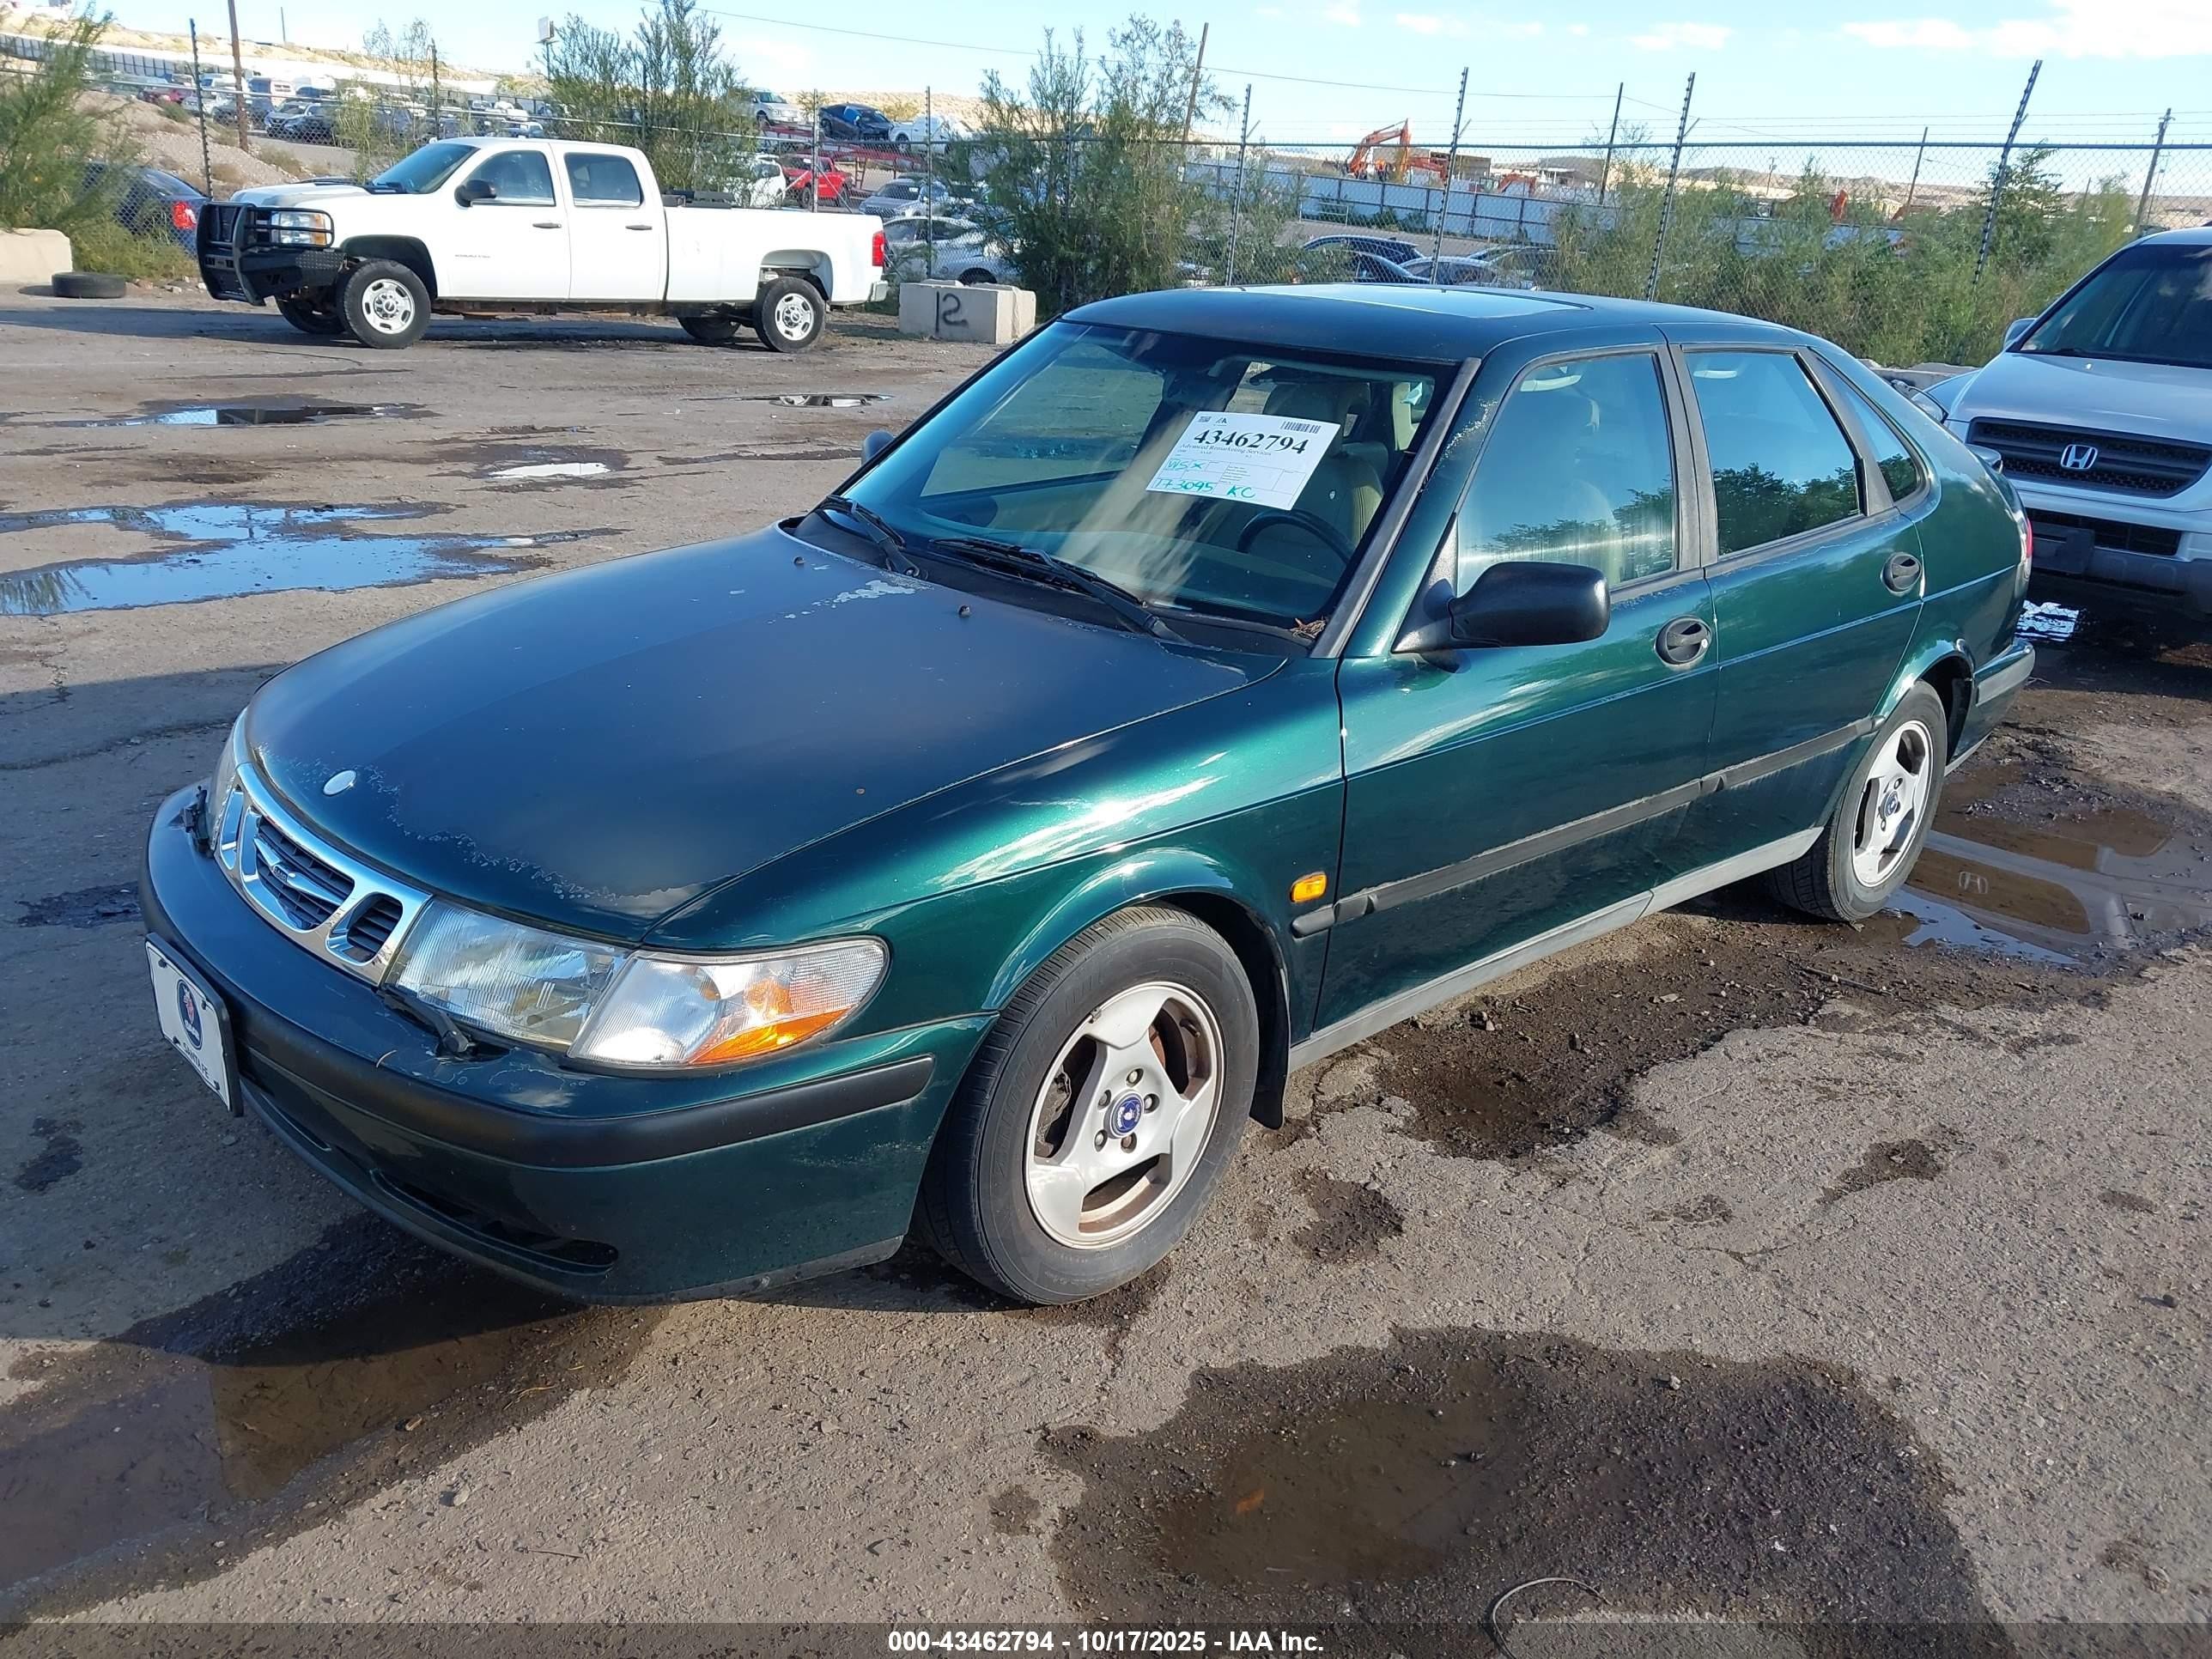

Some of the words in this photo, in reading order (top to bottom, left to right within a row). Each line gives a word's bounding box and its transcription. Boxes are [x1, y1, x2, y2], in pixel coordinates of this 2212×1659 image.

[936, 291, 968, 333] 12
[1194, 429, 1310, 454] 43462794
[183, 1042, 201, 1069] SANTA
